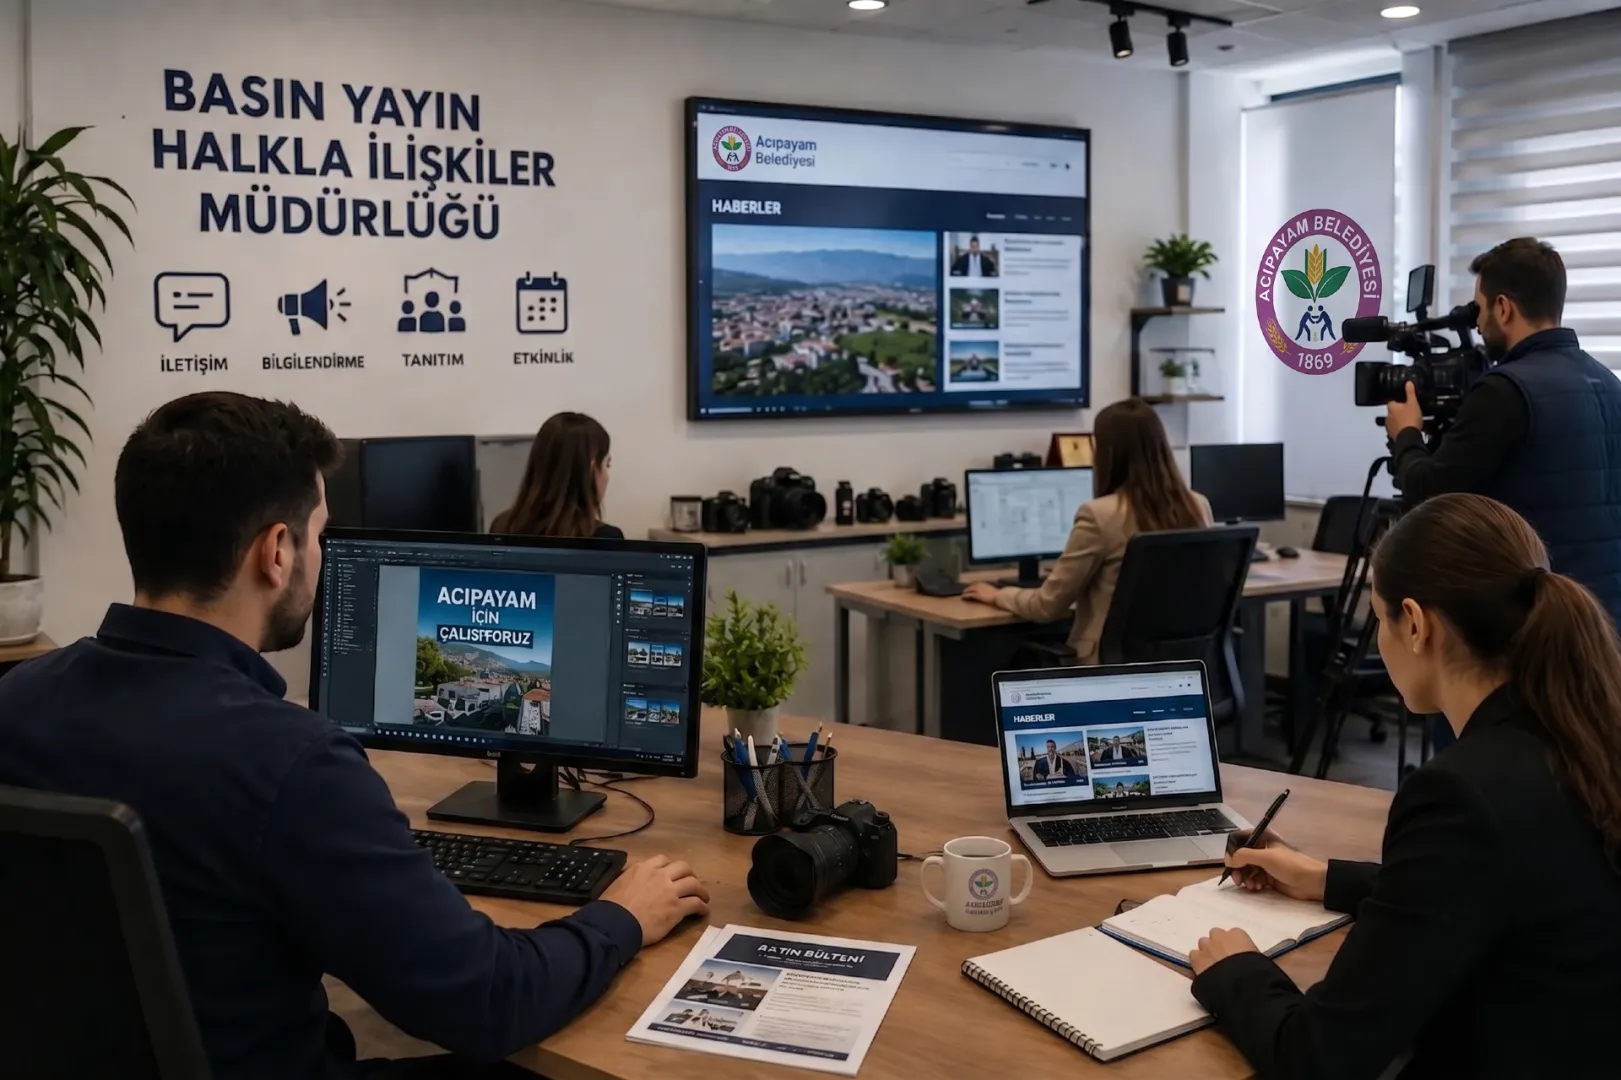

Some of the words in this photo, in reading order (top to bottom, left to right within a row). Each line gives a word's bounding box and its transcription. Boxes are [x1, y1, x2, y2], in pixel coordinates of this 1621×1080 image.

[163, 68, 325, 121] BASIN
[341, 83, 481, 133] YAYIN
[755, 135, 817, 153] Acıpayam
[152, 127, 353, 178] HALKLA
[368, 131, 556, 192] İLİŞKİLER
[755, 152, 816, 169] Belediyesi
[199, 183, 501, 241] MÜDÜRLÜĞÜ
[711, 198, 782, 215] HABERLER
[1259, 217, 1309, 302] ACIPAYAM
[1313, 215, 1380, 300] BELEDİYESİ
[160, 353, 229, 376] İLETİŞİM
[262, 352, 365, 370] BİLGİLENDİRME
[401, 353, 464, 367] TANITIM
[513, 349, 574, 365] ETKİNLİK
[1297, 352, 1333, 370] 1869
[436, 586, 536, 610] ACIPAYAM
[471, 606, 499, 626] İÇİN
[1013, 713, 1056, 723] HABERLER
